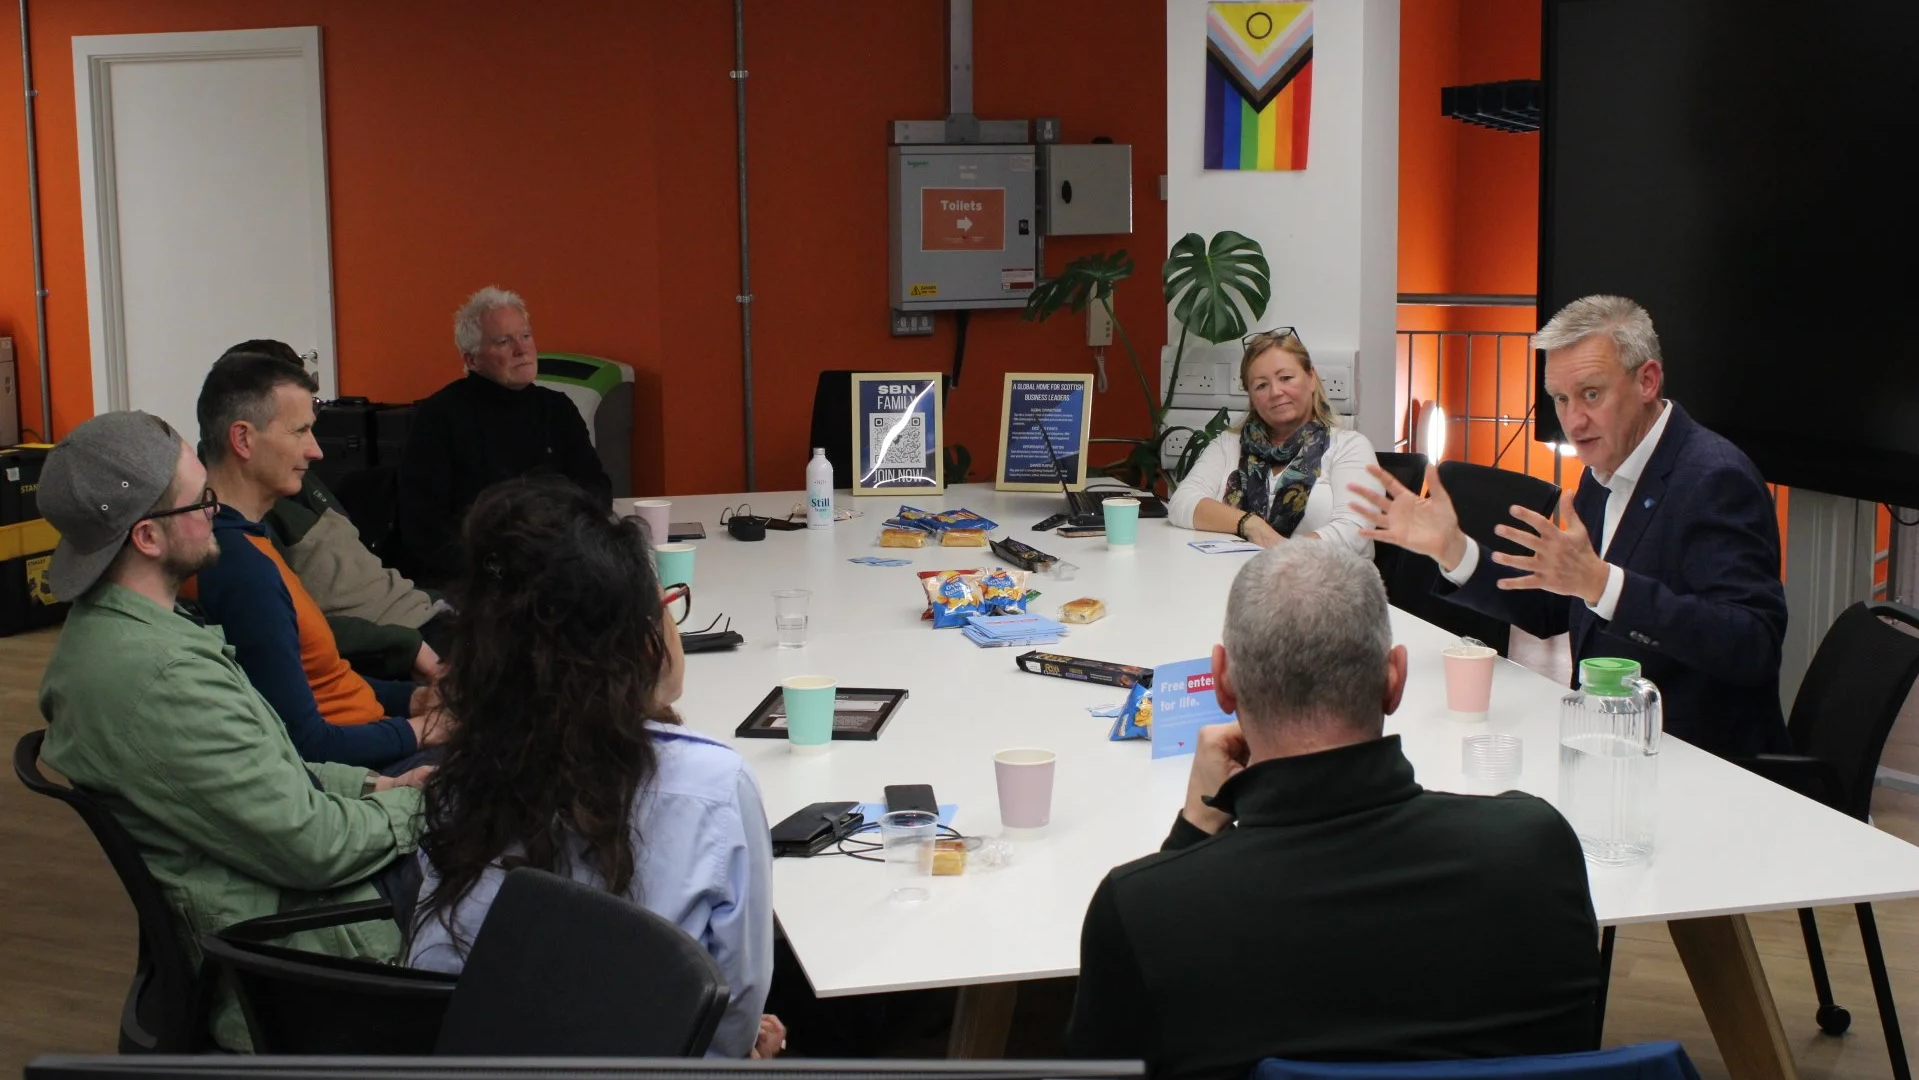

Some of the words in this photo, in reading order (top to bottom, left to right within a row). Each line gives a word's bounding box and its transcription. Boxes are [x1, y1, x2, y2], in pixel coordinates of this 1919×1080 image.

[941, 199, 982, 211] Toilets
[878, 385, 916, 395] SBN
[873, 469, 895, 483] JOIN
[898, 469, 923, 483] NOW
[811, 498, 830, 508] Still
[1160, 682, 1185, 693] Free
[1160, 701, 1176, 712] for
[1180, 697, 1200, 708] life.
